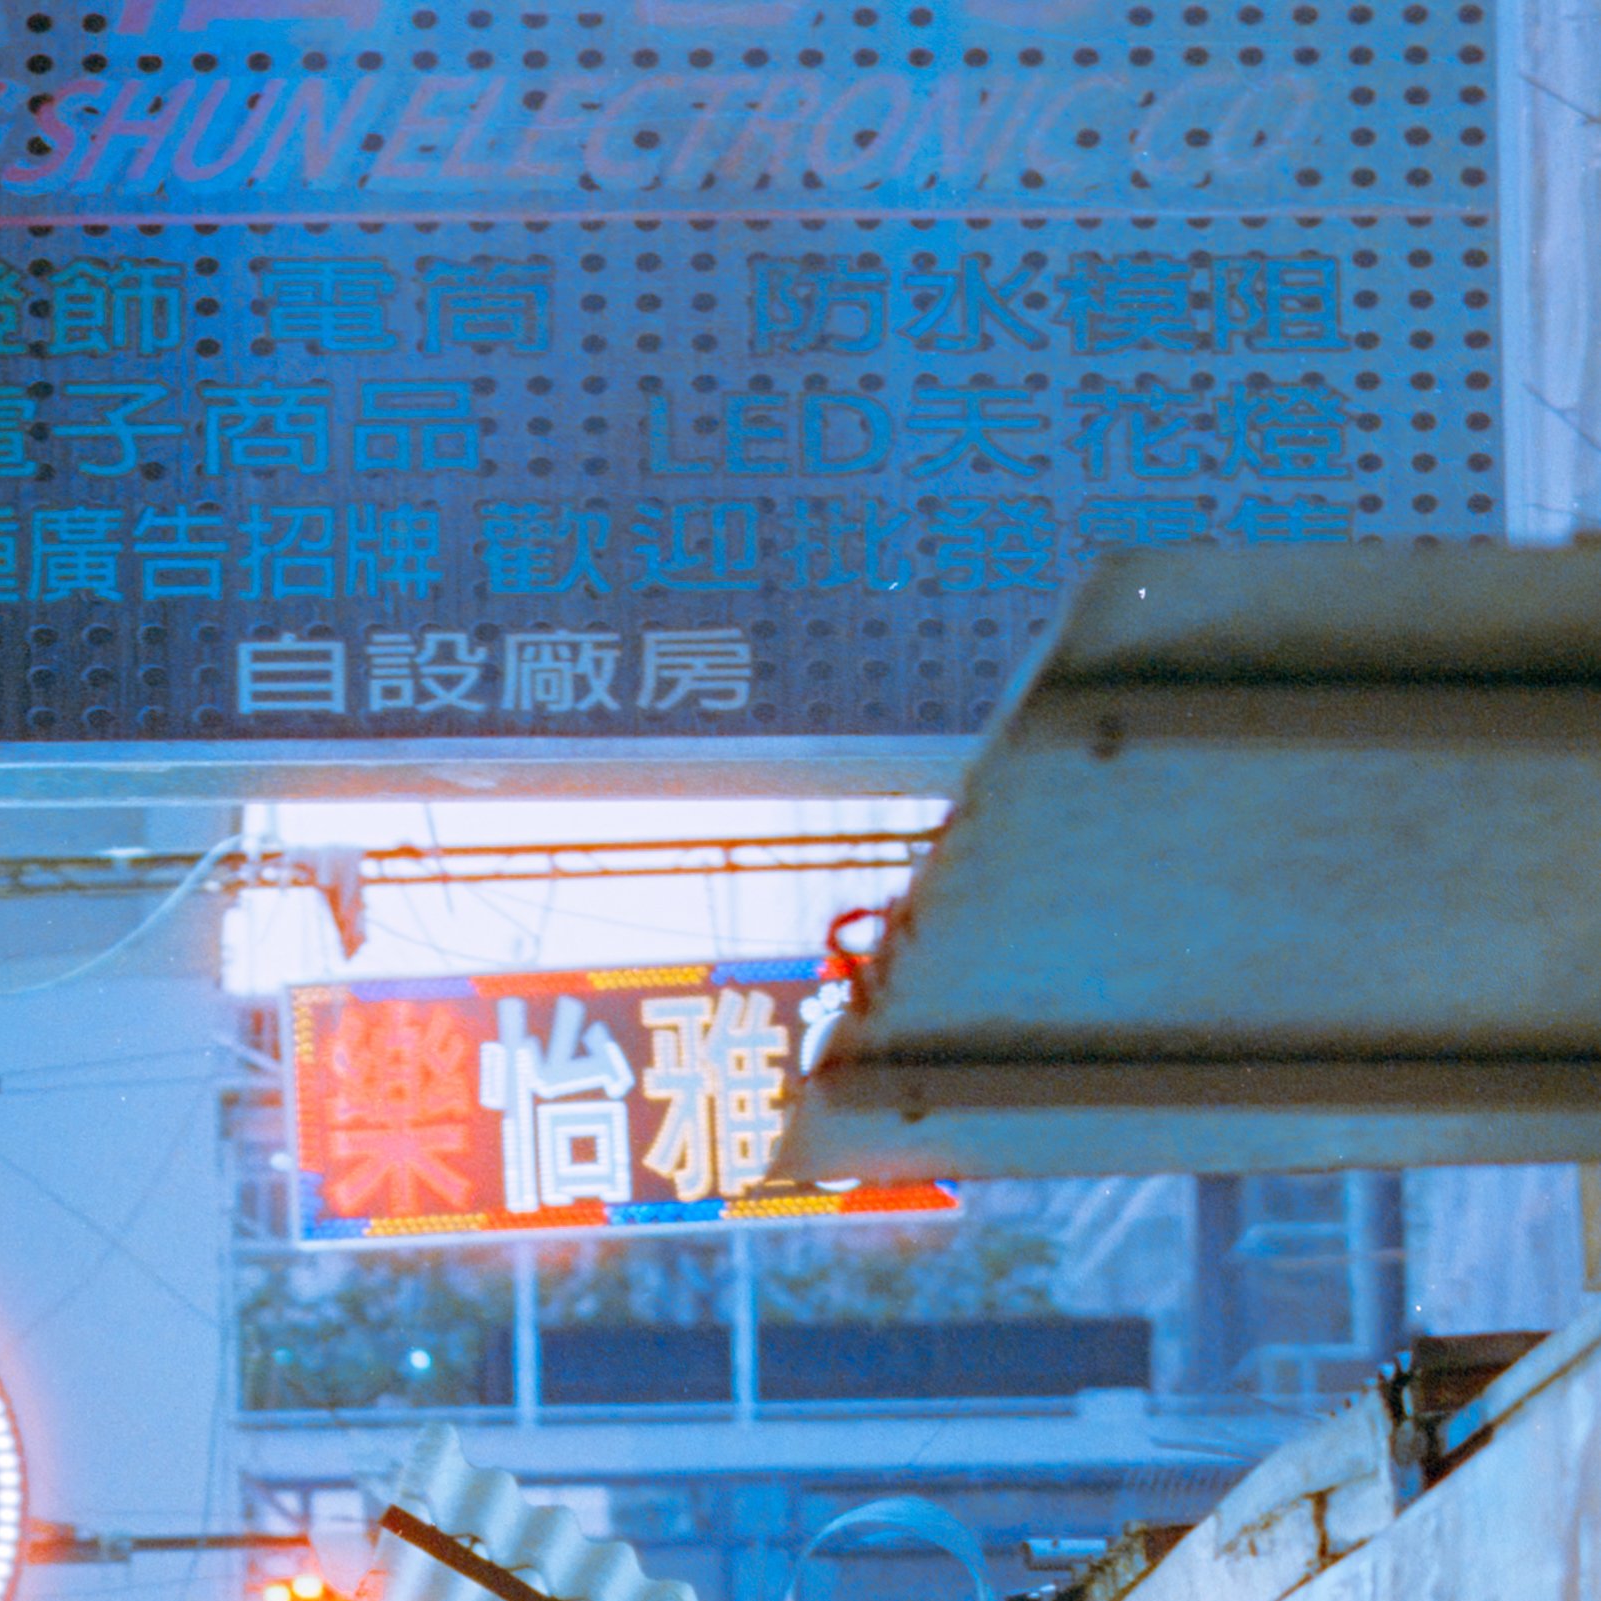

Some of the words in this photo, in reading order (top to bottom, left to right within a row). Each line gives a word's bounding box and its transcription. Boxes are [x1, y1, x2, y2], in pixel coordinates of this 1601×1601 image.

[5, 77, 383, 188] SHUN
[372, 74, 1131, 180] ELECTRONIC
[258, 257, 551, 356] 電筒
[645, 382, 1354, 482] LED天花燈
[235, 627, 753, 715] 自設廠房
[323, 988, 795, 1220] 樂怡雅
